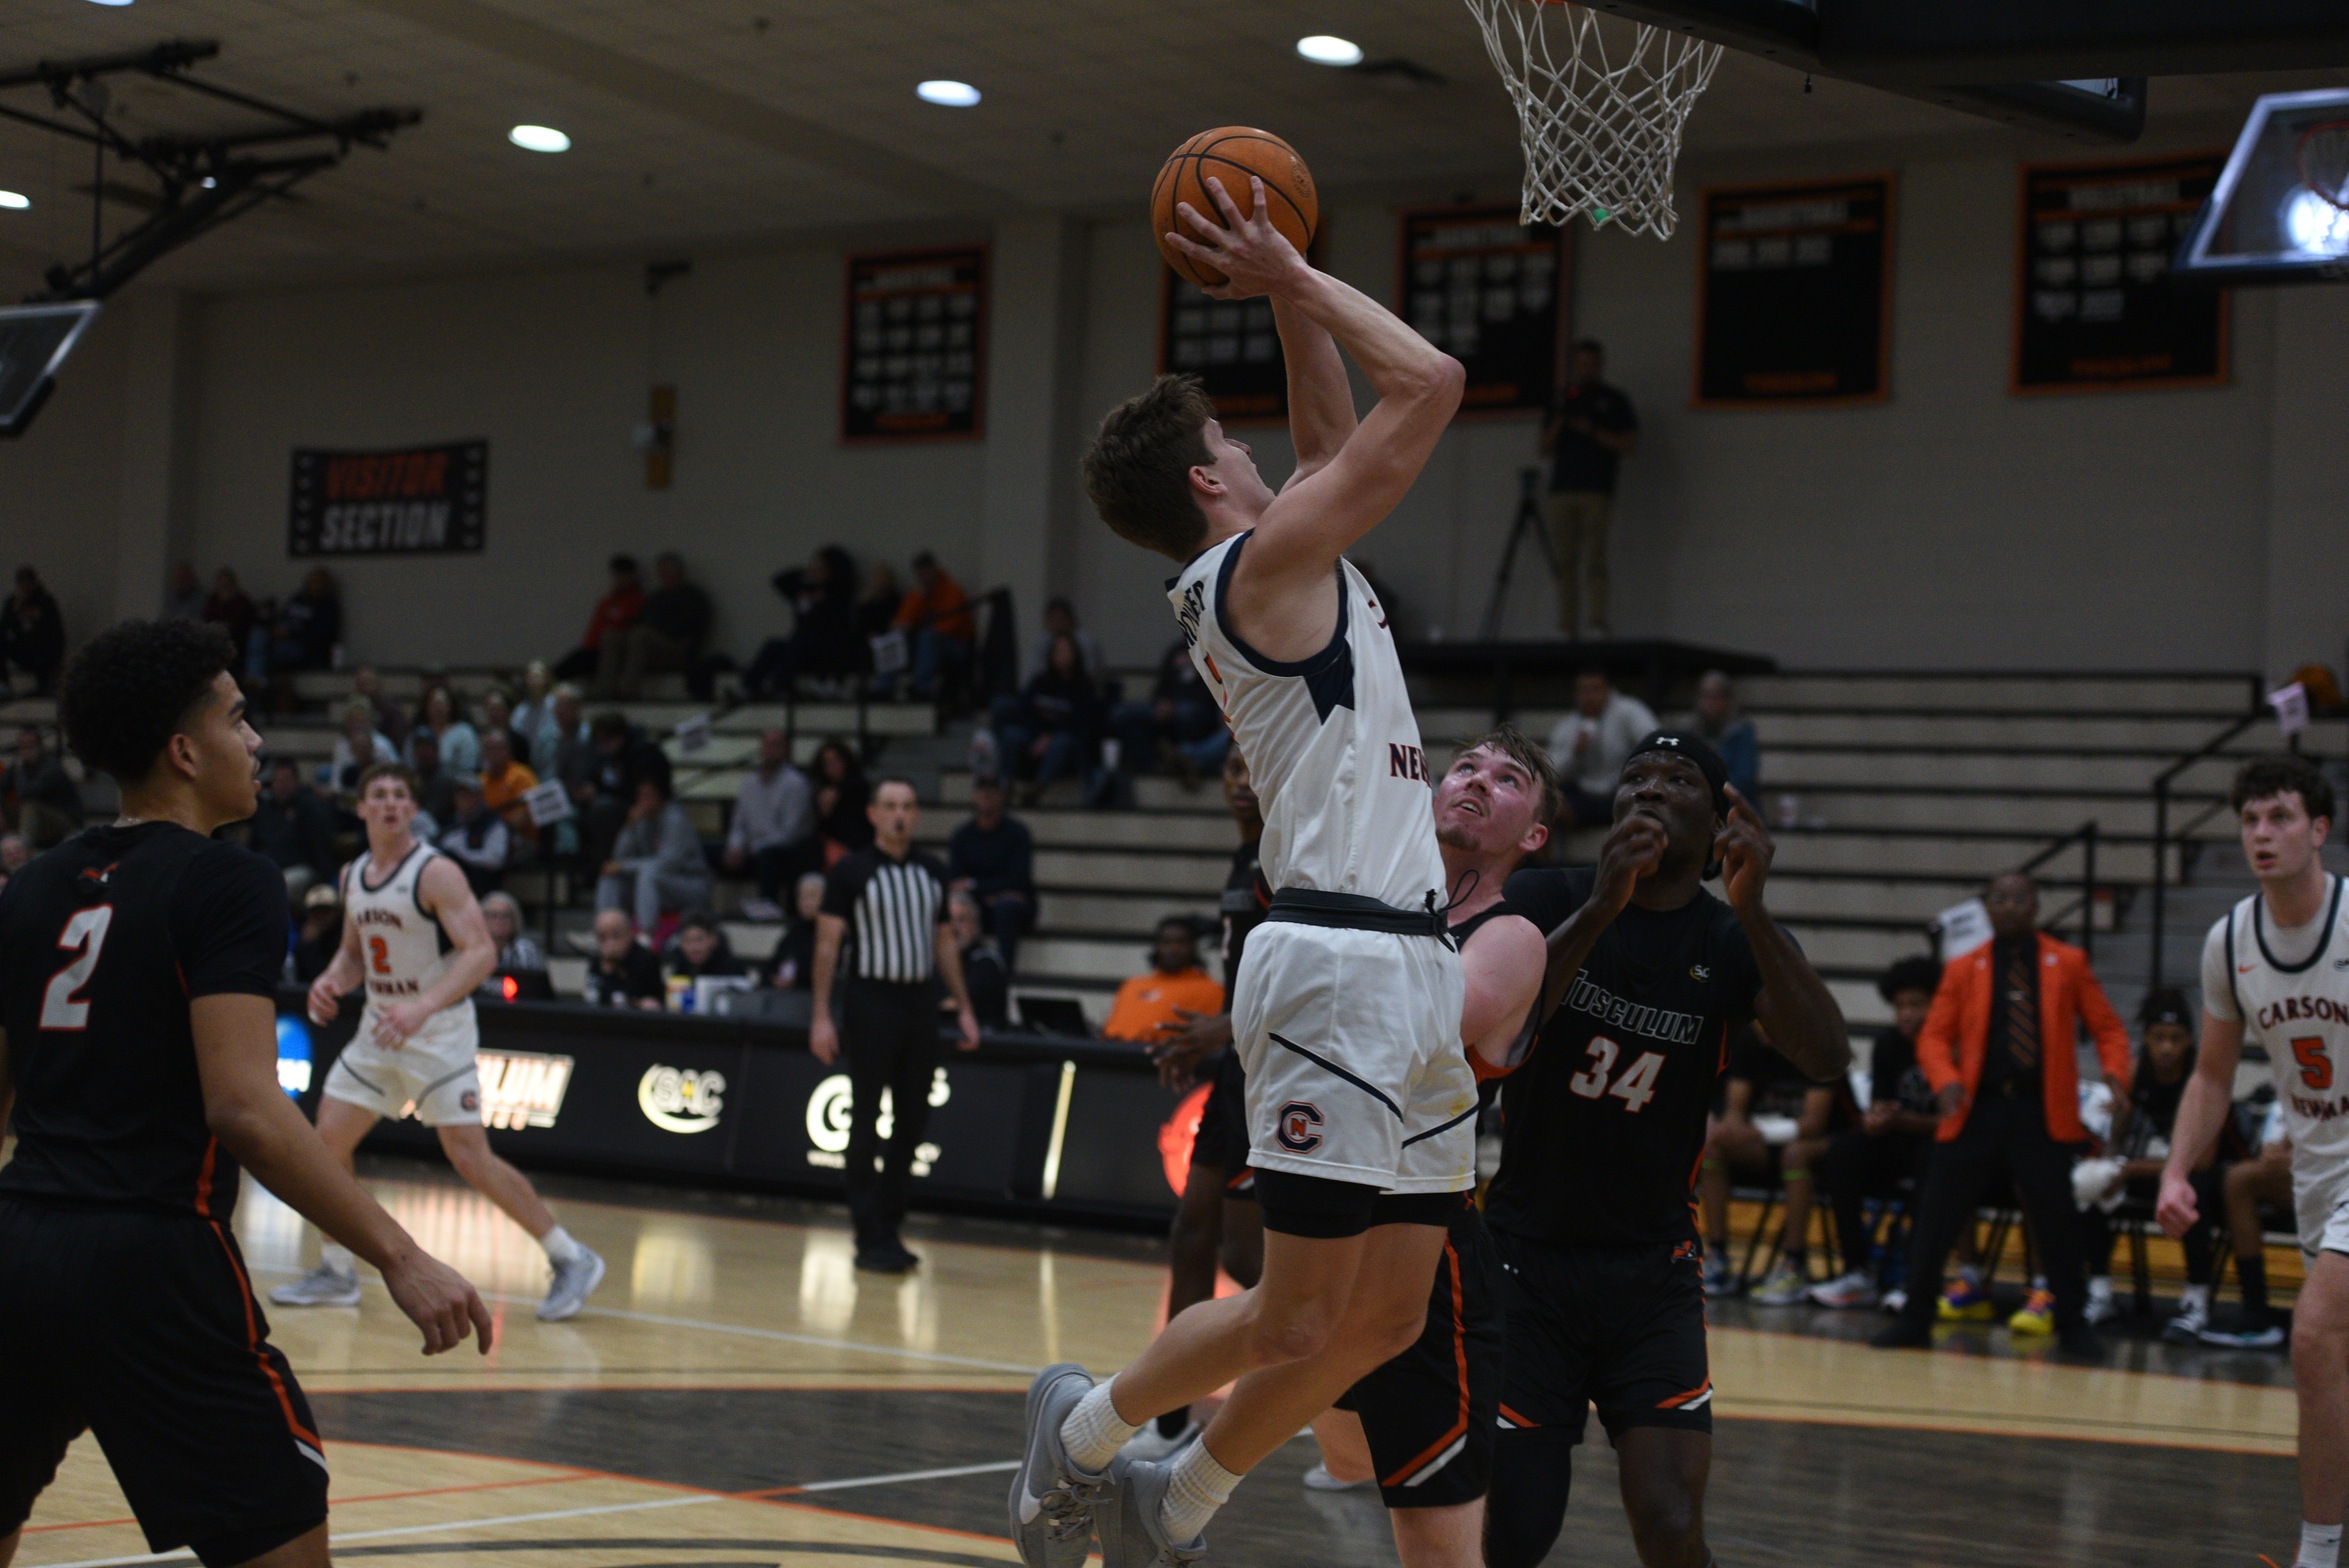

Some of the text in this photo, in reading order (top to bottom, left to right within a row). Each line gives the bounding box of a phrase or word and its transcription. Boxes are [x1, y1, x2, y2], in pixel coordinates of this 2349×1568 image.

[326, 452, 450, 500] VISITOR
[319, 501, 451, 551] SECTION
[37, 902, 115, 1031] 2
[369, 936, 392, 975] 2
[1561, 967, 1704, 1045] TUSCULUM
[2258, 995, 2349, 1029] CARSON
[1567, 1032, 1668, 1115] 34
[2290, 1035, 2334, 1090] 5
